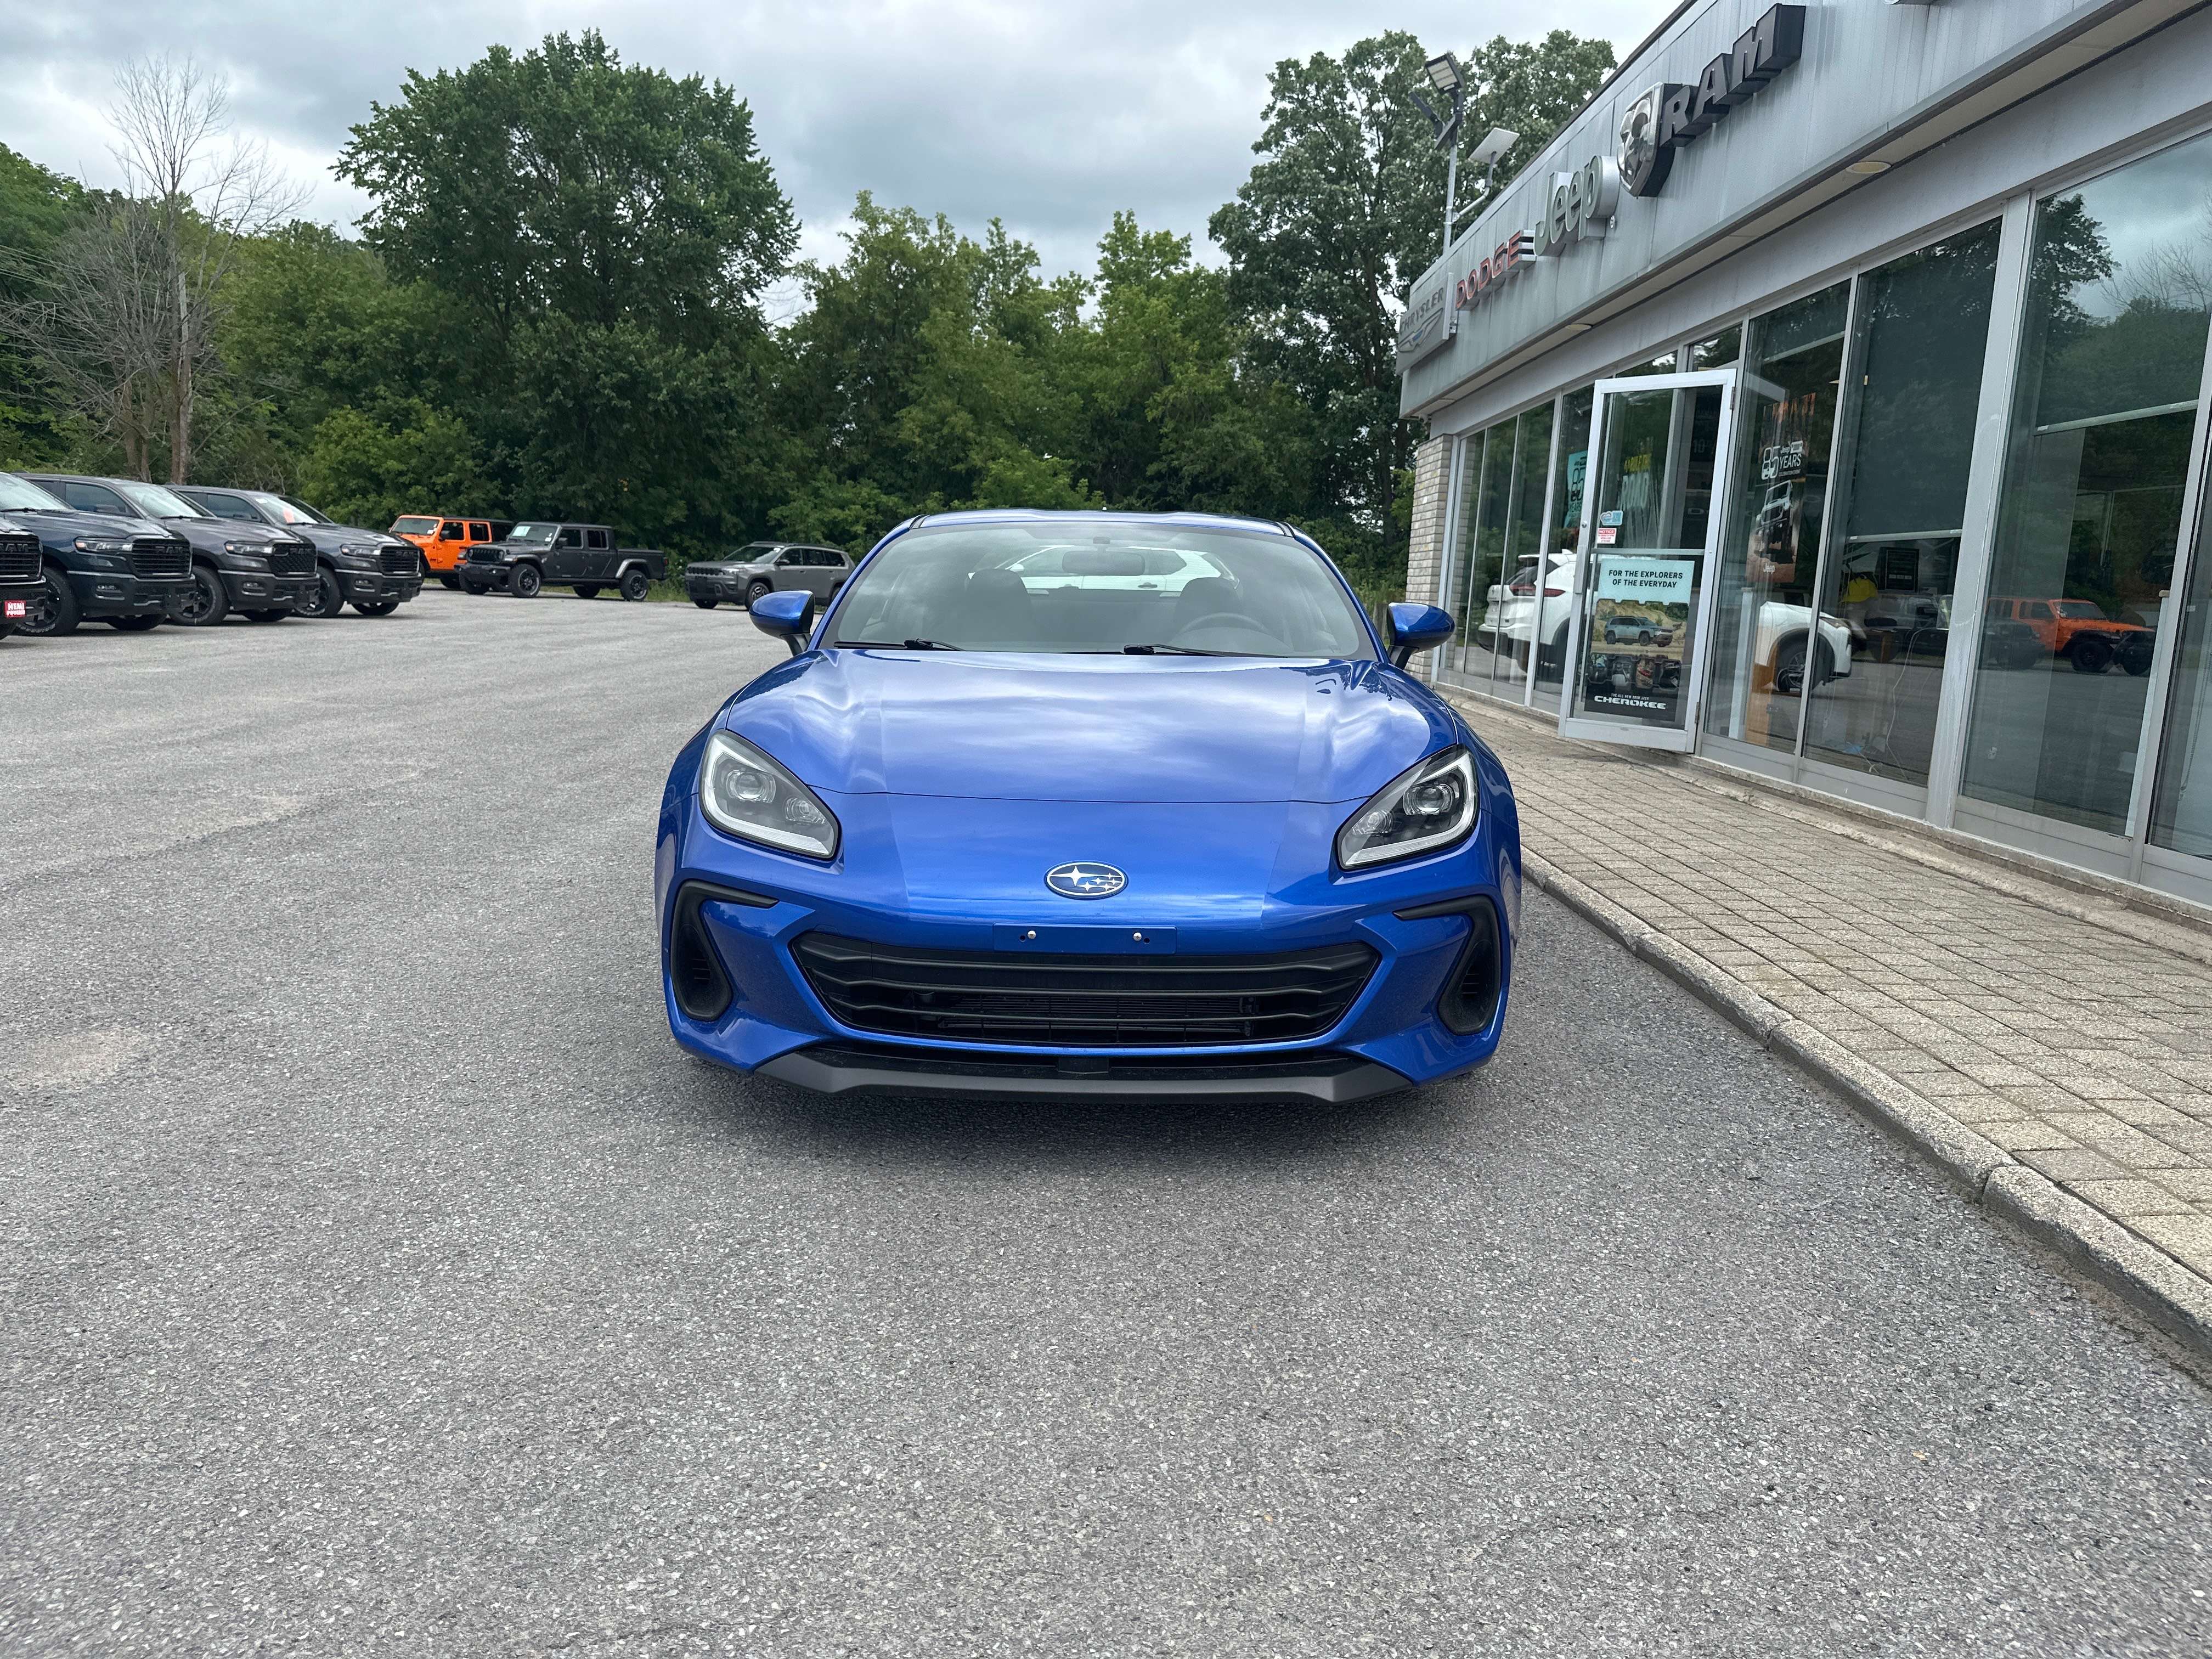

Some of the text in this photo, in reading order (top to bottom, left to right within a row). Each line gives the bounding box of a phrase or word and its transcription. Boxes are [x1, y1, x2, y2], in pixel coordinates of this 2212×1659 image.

[1660, 3, 1804, 148] RAM
[1534, 156, 1605, 256] Jeep
[1455, 230, 1523, 310] DODGE
[1400, 287, 1444, 334] CHRYSLER
[1762, 445, 1802, 480] 85 YEARS
[1639, 580, 1677, 588] EVERYDAY
[1763, 563, 1775, 574] Jeep
[1594, 695, 1667, 709] CHEROKEE
